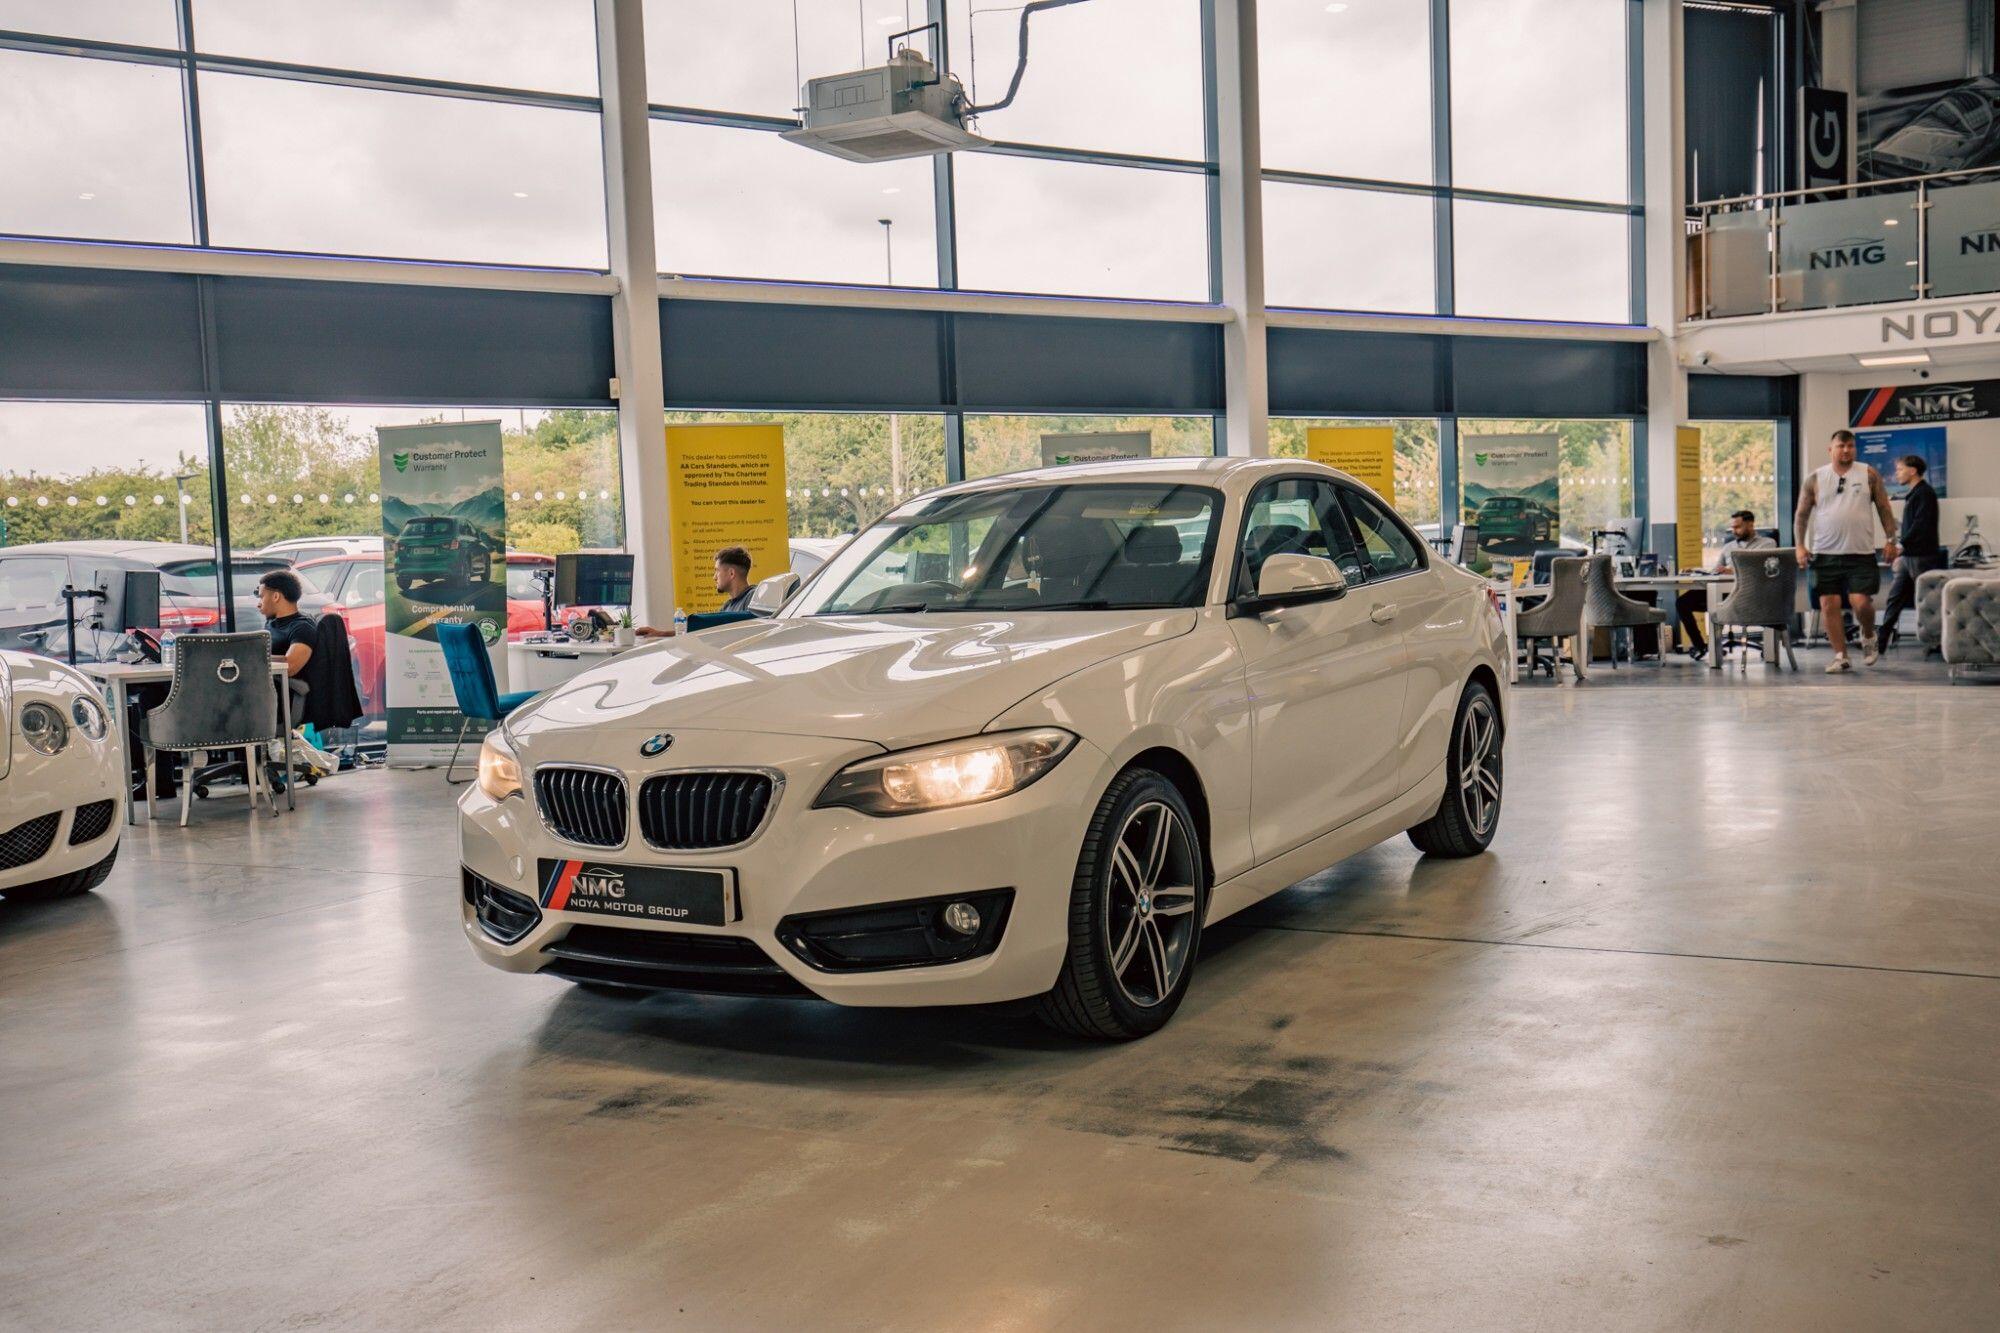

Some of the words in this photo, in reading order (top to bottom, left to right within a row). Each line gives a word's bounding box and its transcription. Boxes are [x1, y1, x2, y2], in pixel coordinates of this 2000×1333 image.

[1810, 245, 1886, 270] NMG
[1882, 307, 2000, 343] NOY
[1899, 393, 1976, 415] NMG
[1953, 410, 1989, 418] GROUP
[413, 452, 453, 461] Customer
[454, 449, 487, 458] Protect
[413, 463, 447, 472] Warranty
[412, 604, 475, 613] Comprehensive
[570, 875, 626, 898] NMG
[570, 899, 600, 909] NOYA
[604, 902, 644, 914] MOTOR
[648, 906, 689, 918] GROUP
